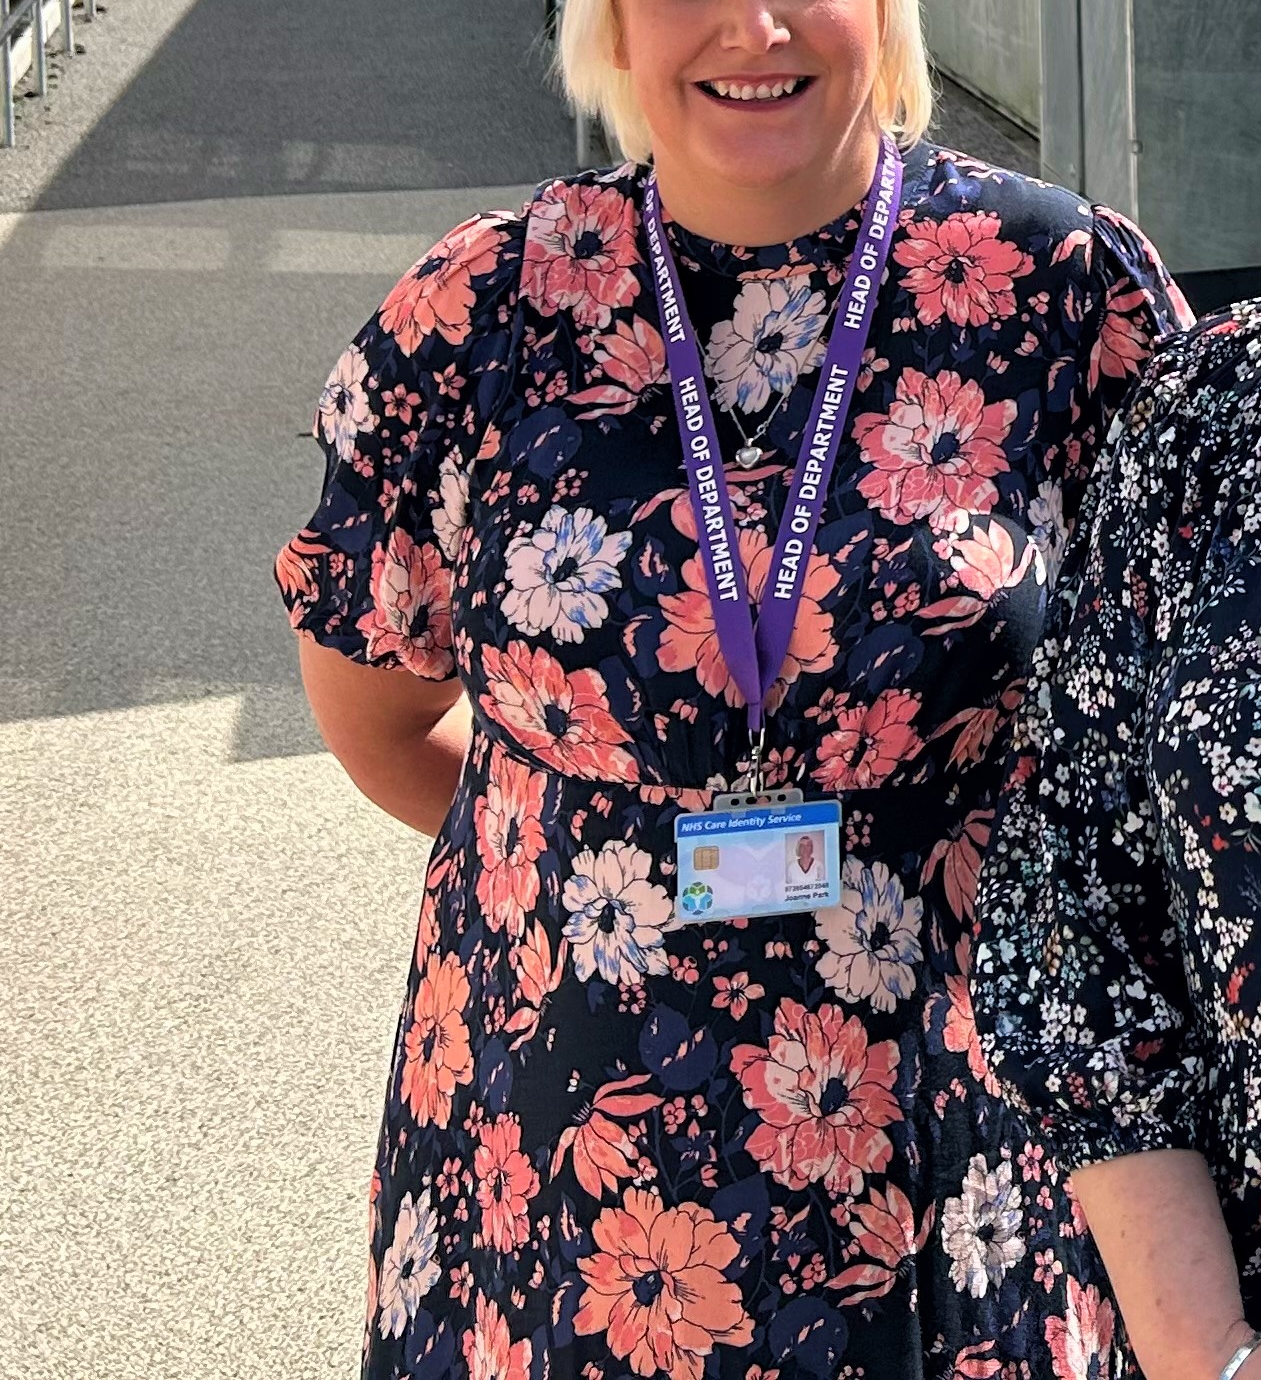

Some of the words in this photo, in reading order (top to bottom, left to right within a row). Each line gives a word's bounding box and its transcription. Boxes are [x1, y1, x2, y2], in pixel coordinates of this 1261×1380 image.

[647, 217, 686, 344] DEPARTMENT
[843, 274, 872, 330] HEAD
[859, 241, 880, 271] OF
[678, 375, 705, 432] HEAD
[799, 364, 849, 500] DEPARTMENT
[690, 435, 711, 462] OF
[695, 465, 739, 602] DEPARTMENT
[790, 504, 812, 534] OF
[774, 539, 804, 600] HEAD
[681, 821, 703, 832] NHS
[705, 821, 727, 830] Care
[728, 816, 766, 829] Identity
[768, 814, 802, 825] Service
